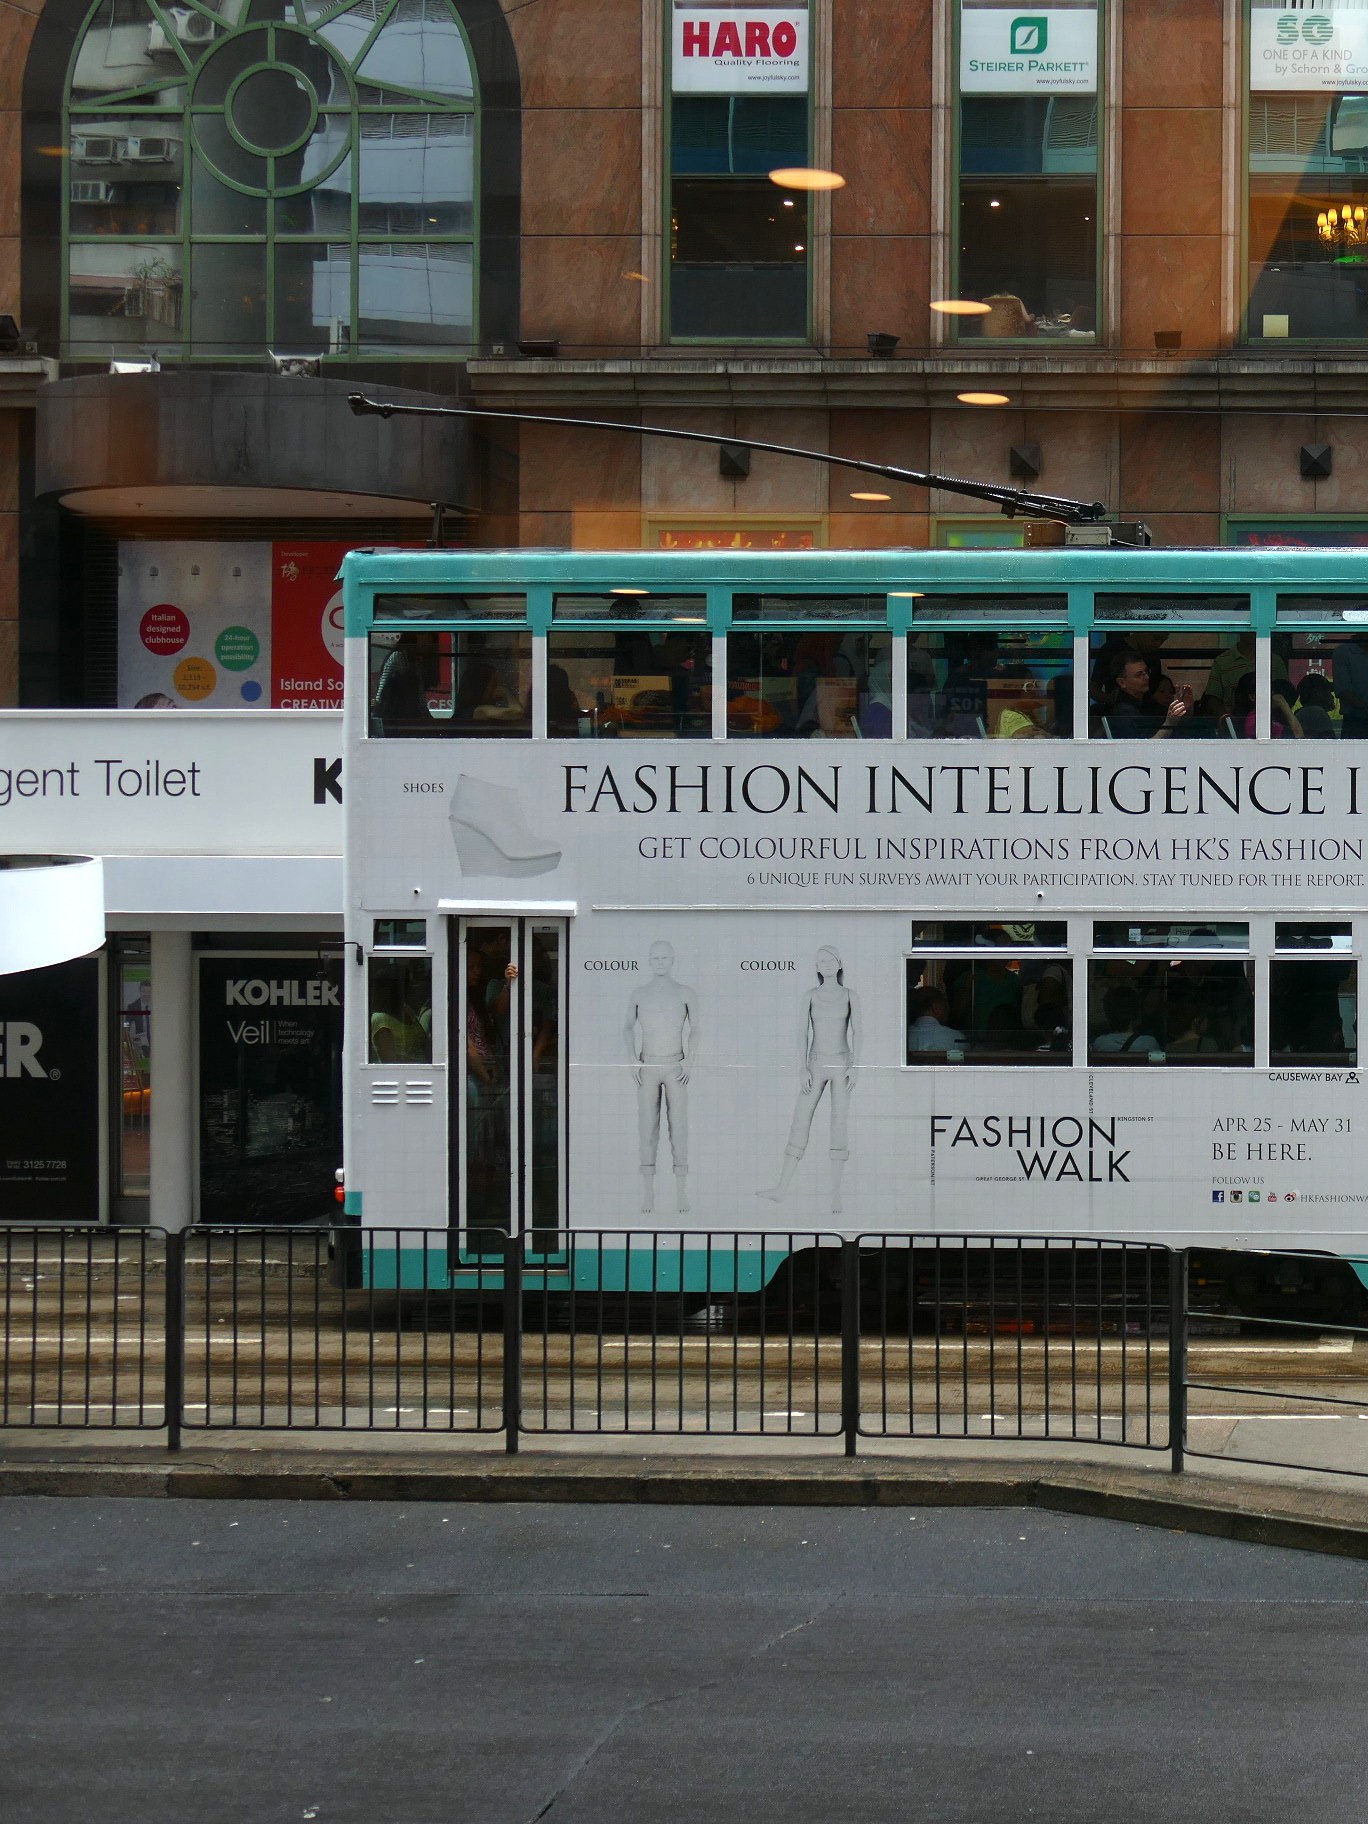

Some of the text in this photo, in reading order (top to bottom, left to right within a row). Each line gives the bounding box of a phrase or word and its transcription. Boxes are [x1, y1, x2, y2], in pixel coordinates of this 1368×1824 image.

[683, 21, 797, 57] HARO
[1262, 49, 1353, 61] ONE OF A KIND
[714, 58, 800, 67] Quality Flooring
[969, 59, 1085, 72] STEIRER PARKETT
[1275, 63, 1288, 76] by
[1290, 63, 1330, 74] Schorn
[1333, 63, 1342, 74] &
[151, 613, 176, 622] Italian
[146, 624, 181, 634] designed
[144, 635, 185, 645] clubhouse
[280, 677, 323, 691] Island
[94, 759, 201, 797] Toilet
[403, 782, 444, 793] SHOES
[560, 764, 843, 814] FASHION
[865, 765, 1326, 816] INTELLIGENCE
[638, 836, 692, 860] GET
[699, 836, 867, 860] COLOURFUL
[877, 837, 1069, 861] INSPIRATIONS
[1080, 838, 1160, 861] FROM
[1171, 837, 1229, 861] HK'S
[1240, 838, 1362, 861] FASHION
[747, 872, 1365, 888] 6 UNIQUE FUN SURVEYS AWAIT YOUR PARTICIPATION. STAY TUNED FOR THE REPORT.
[583, 960, 639, 971] COLOUR
[740, 960, 796, 971] COLOUR
[226, 979, 341, 1006] KOHLER
[278, 1020, 298, 1029] When
[226, 1020, 270, 1045] Veil
[278, 1028, 315, 1039] technology
[278, 1037, 299, 1045] meets
[1268, 1072, 1344, 1082] CAUSEWAY BAY
[1213, 1117, 1248, 1133] APR
[1253, 1117, 1272, 1133] 25
[1290, 1118, 1329, 1133] MAY
[1334, 1118, 1352, 1133] 31
[930, 1115, 1117, 1148] FASHION
[1212, 1142, 1312, 1161] BE HERE.
[23, 1160, 45, 1169] 3125
[45, 1160, 67, 1169] 7728
[1016, 1149, 1131, 1183] WALK
[1212, 1176, 1265, 1185] FOLLOW US
